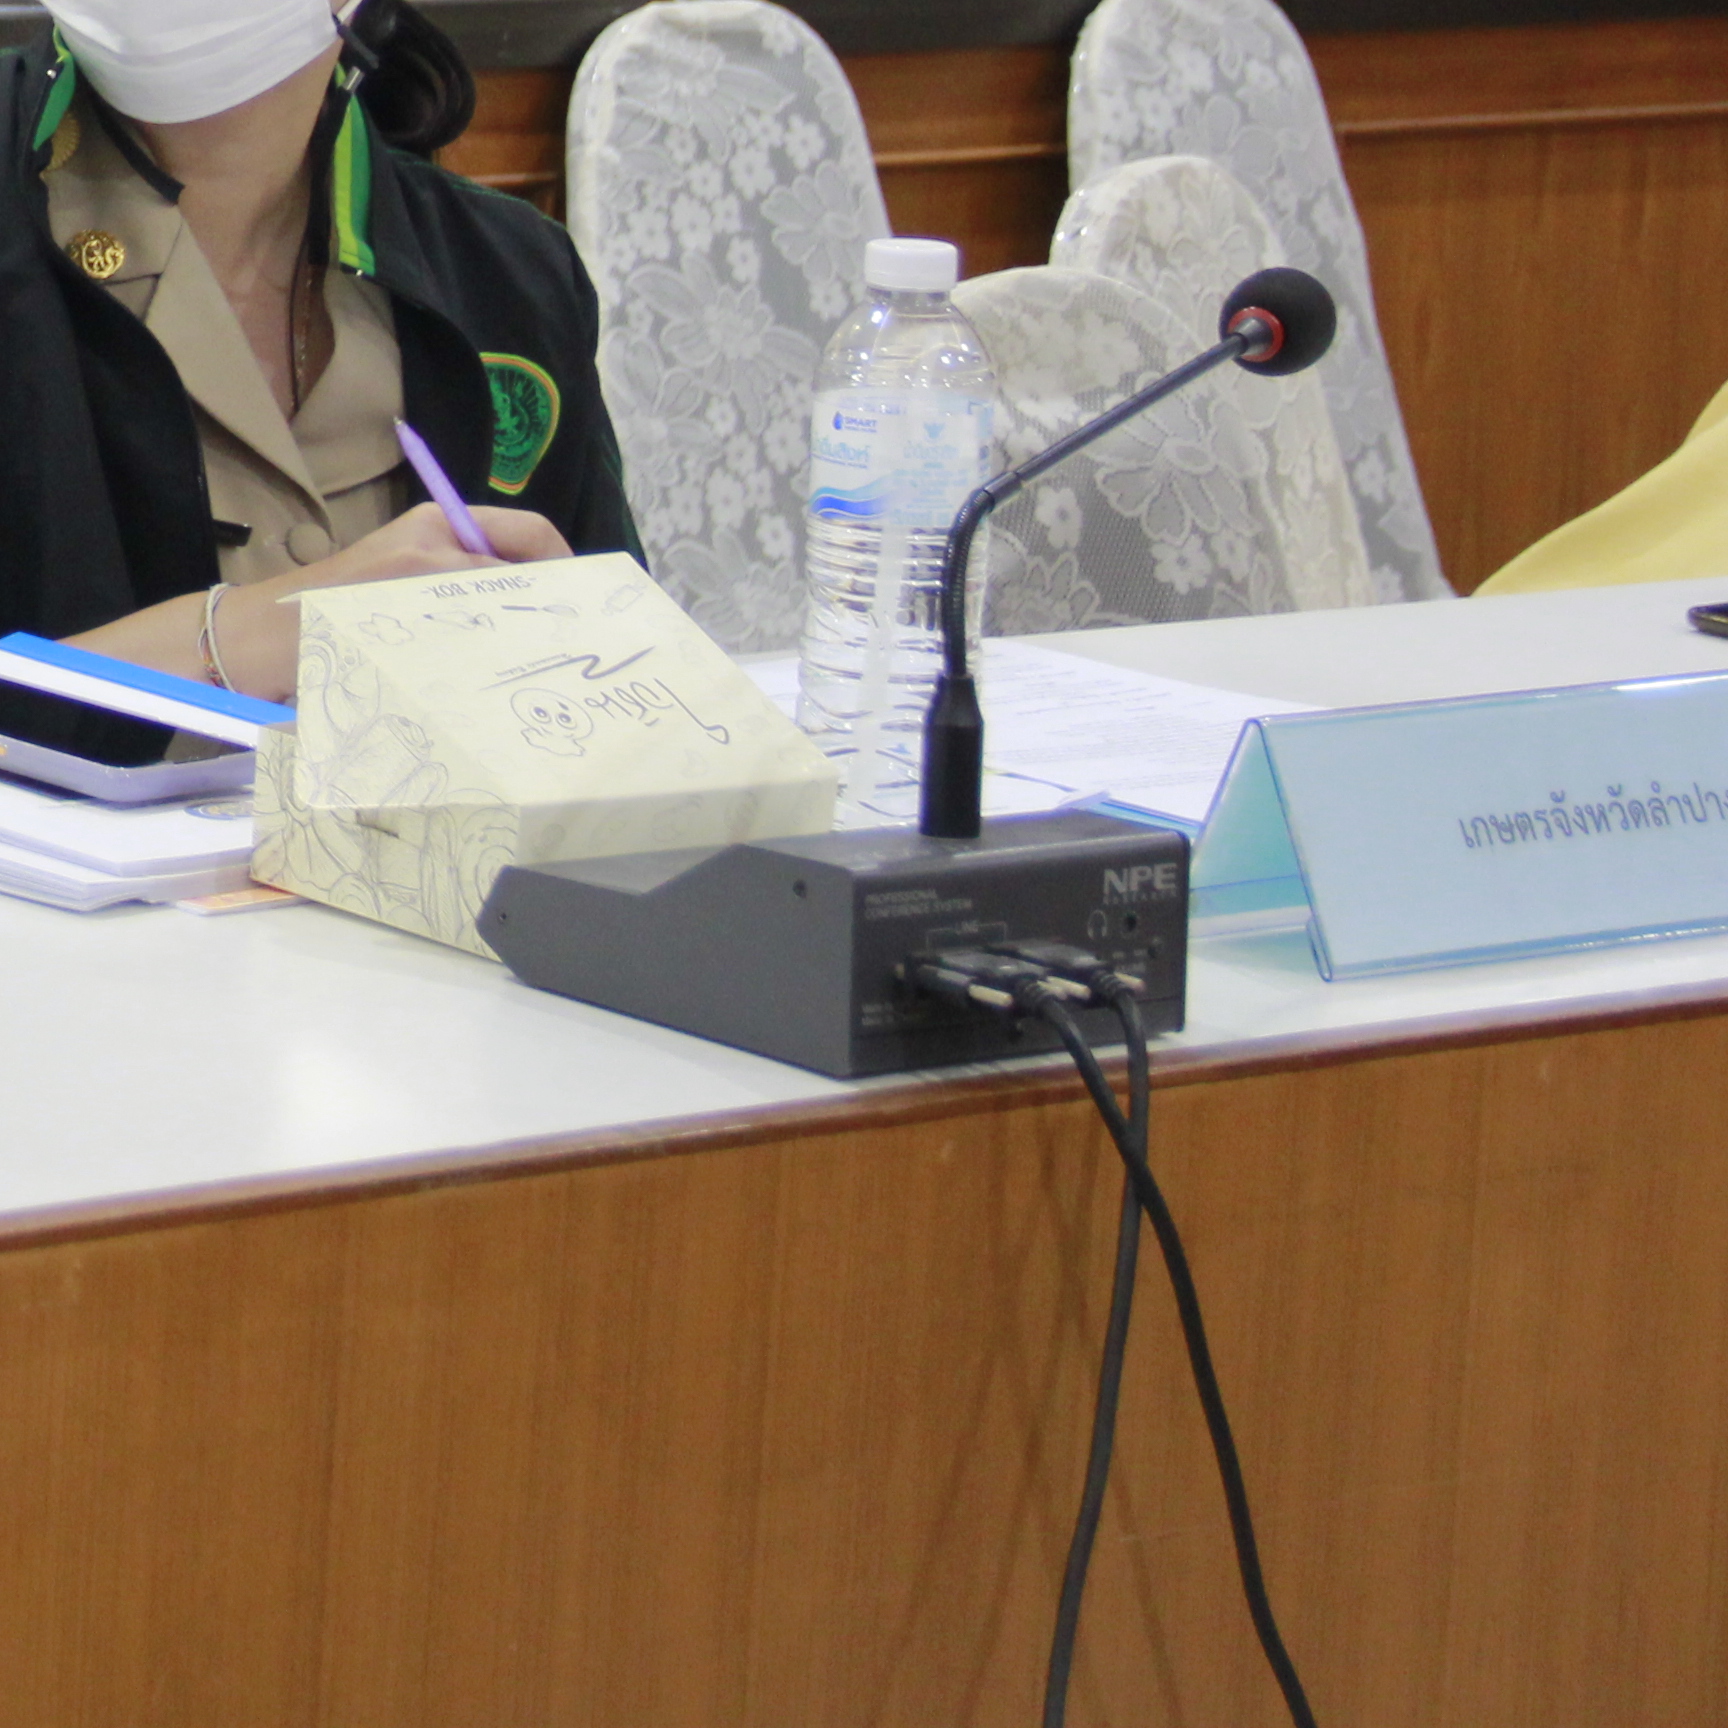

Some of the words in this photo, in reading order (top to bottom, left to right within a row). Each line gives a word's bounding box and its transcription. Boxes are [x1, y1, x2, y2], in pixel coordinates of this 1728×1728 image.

[1458, 780, 1728, 849] เกษตรจังหวัดลำปา
[1103, 863, 1178, 894] NPE
